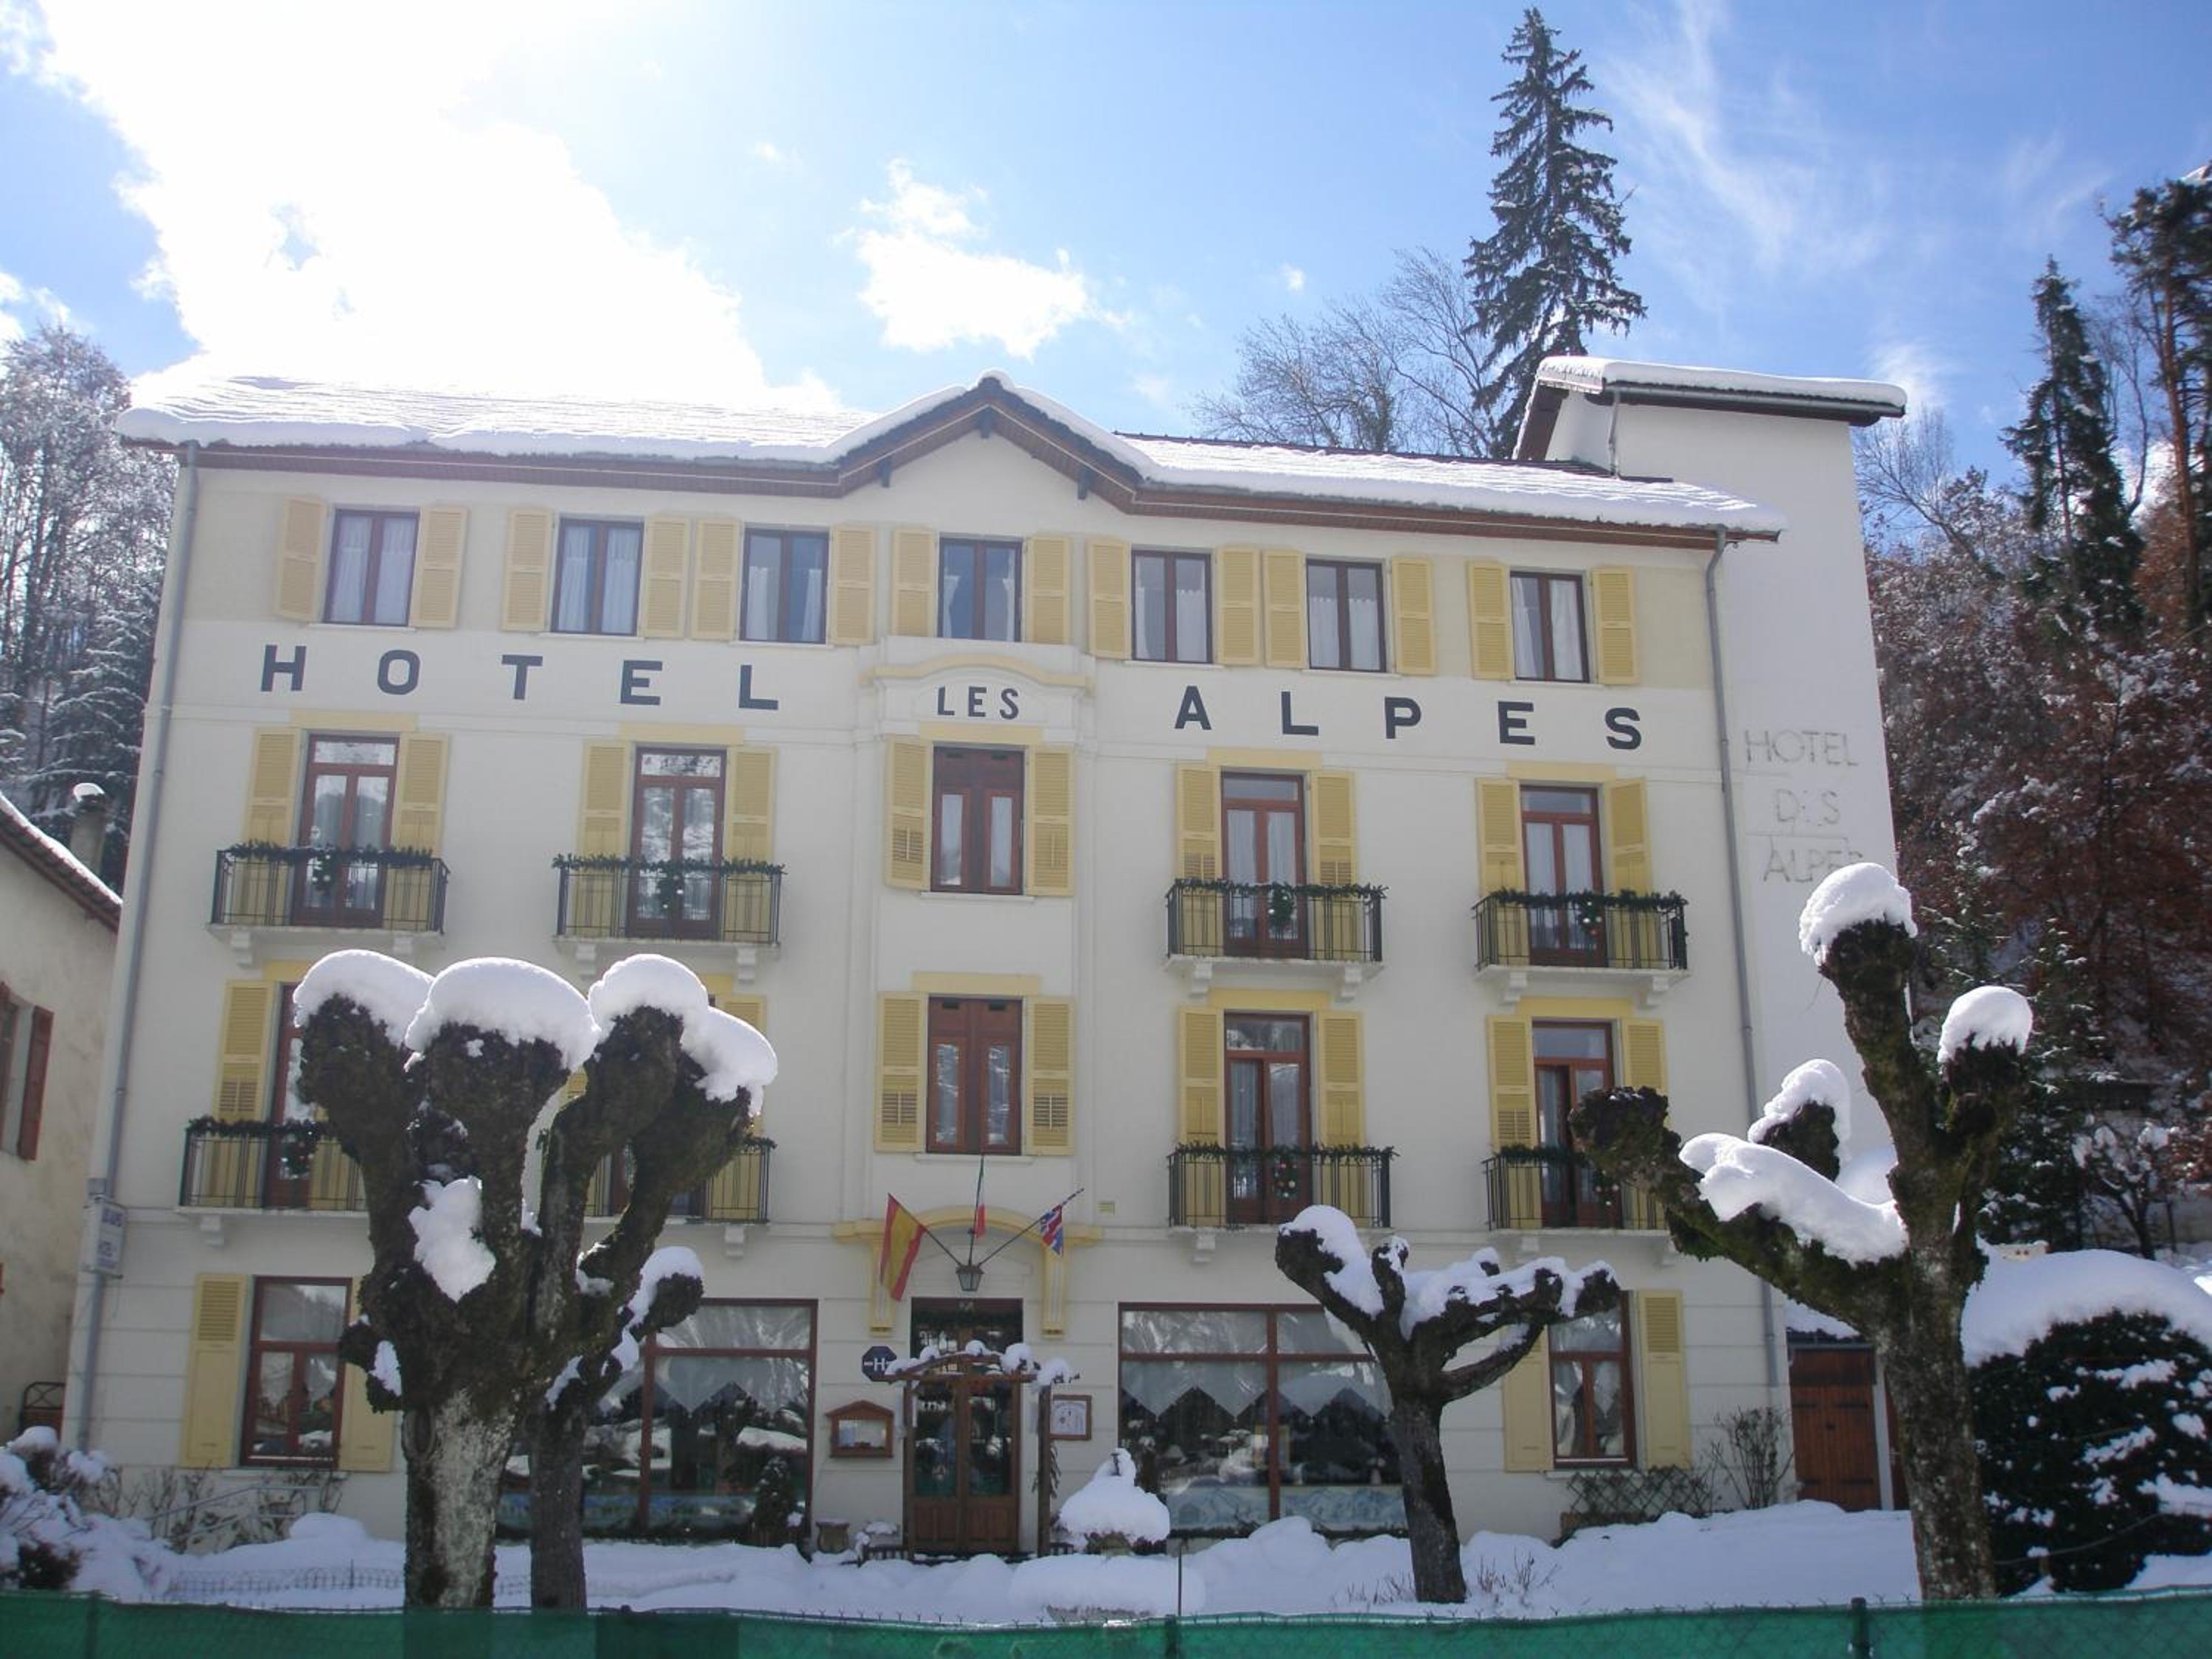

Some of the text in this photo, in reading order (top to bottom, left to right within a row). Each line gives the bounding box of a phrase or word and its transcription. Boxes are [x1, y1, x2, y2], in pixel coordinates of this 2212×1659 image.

[260, 644, 1642, 749] HOTEL LES ALPES
[1745, 729, 1859, 766] HOTEL
[1775, 788, 1840, 826] DS
